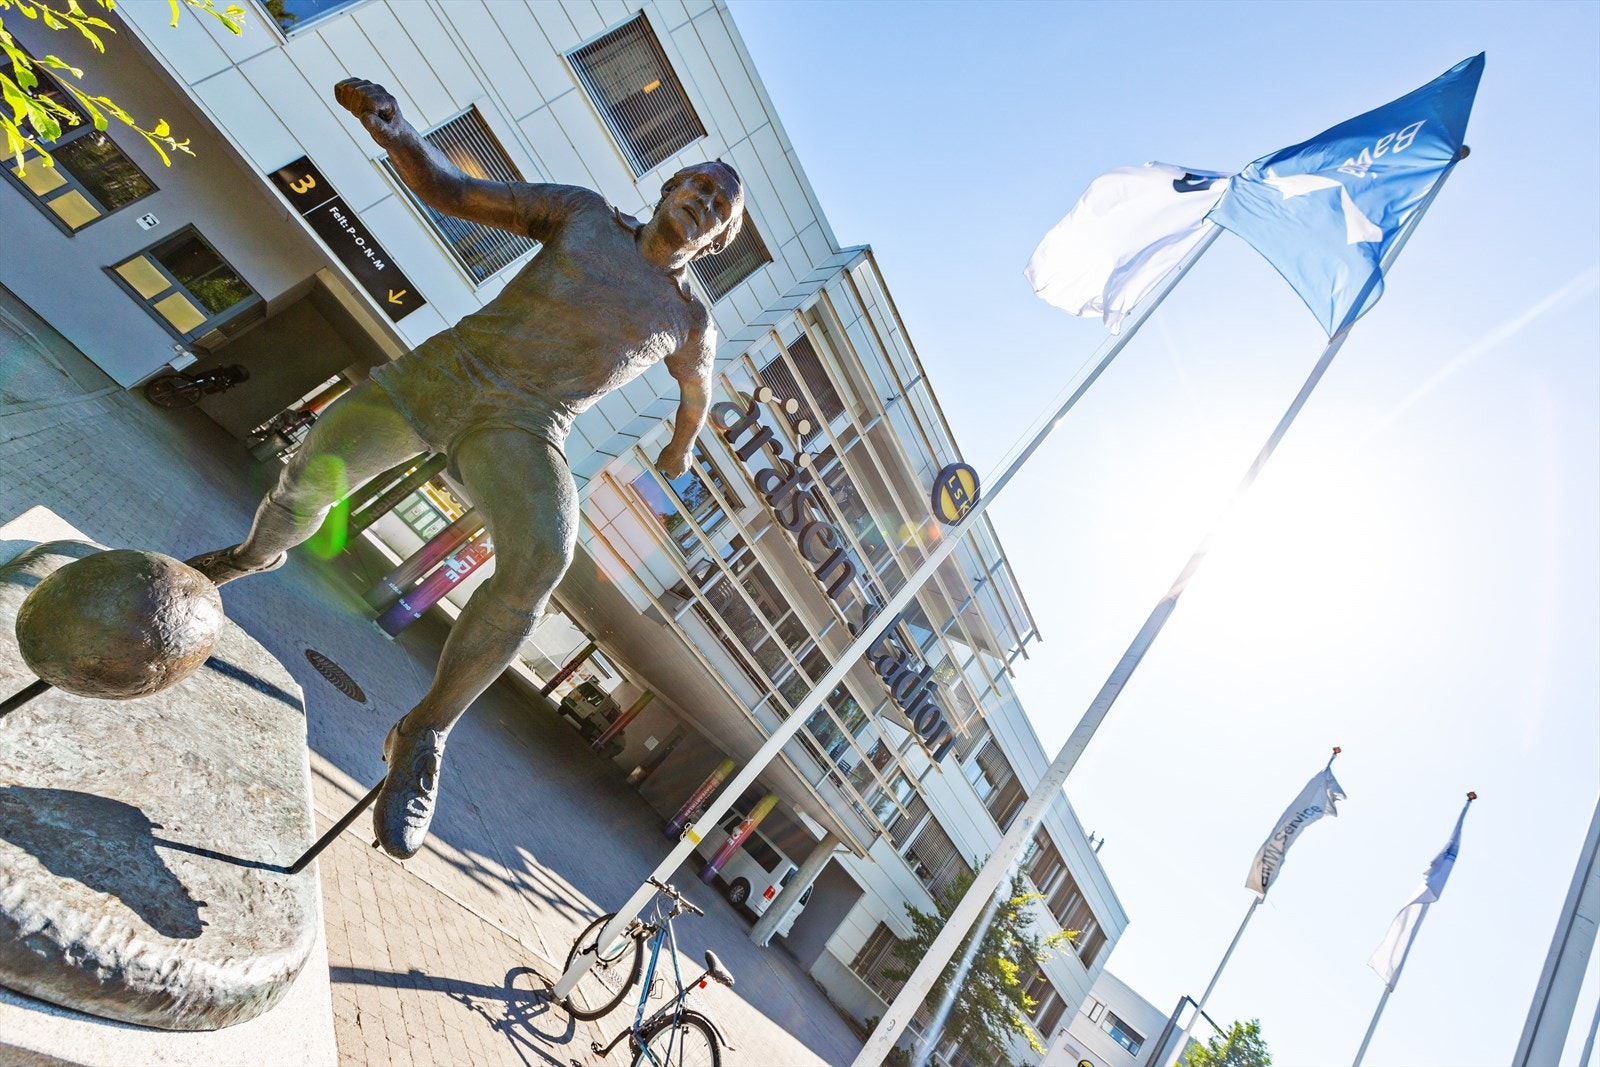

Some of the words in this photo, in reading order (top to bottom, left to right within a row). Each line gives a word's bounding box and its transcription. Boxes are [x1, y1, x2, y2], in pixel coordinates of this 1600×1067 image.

[289, 173, 317, 195] 3
[328, 206, 349, 229] Felt:
[346, 227, 385, 271] P-O-N-M
[1274, 805, 1323, 846] Service
